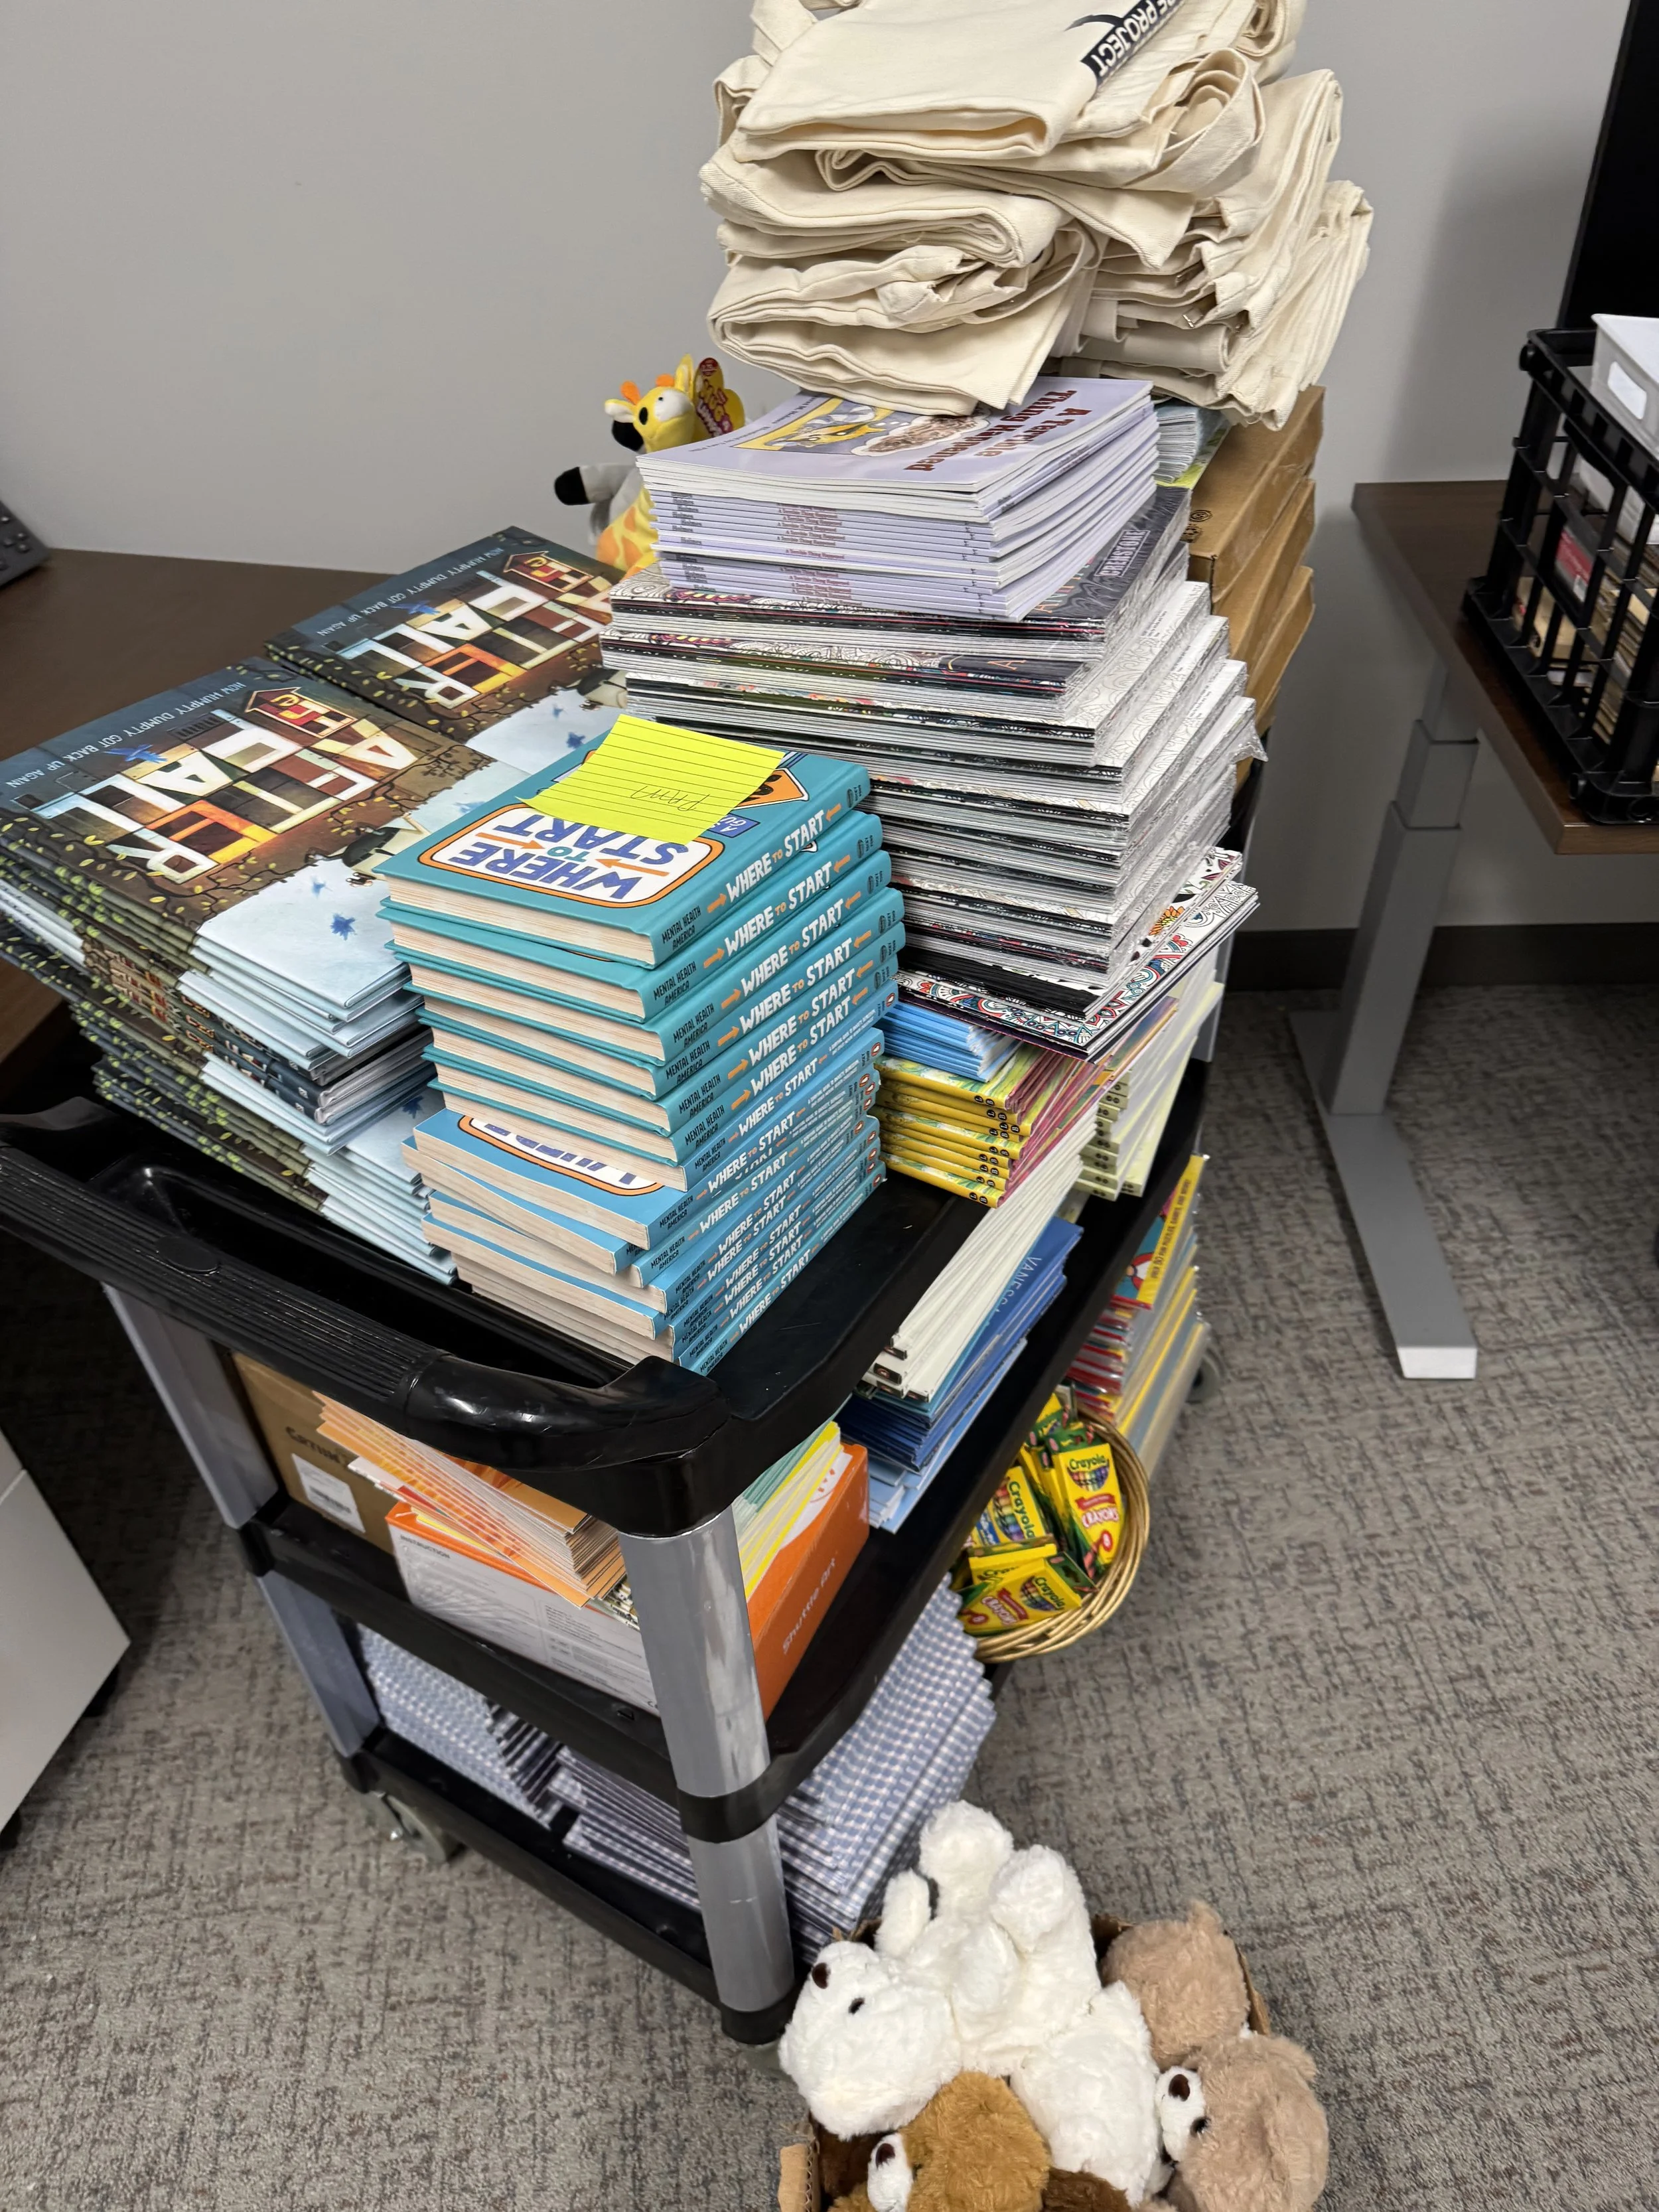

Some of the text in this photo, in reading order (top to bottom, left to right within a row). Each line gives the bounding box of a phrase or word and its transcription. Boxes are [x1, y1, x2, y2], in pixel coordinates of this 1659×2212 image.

[1091, 1, 1158, 76] PROJECT
[904, 390, 1077, 471] Thing Happened
[1055, 407, 1092, 416] A
[316, 548, 504, 636] HOW HUMPTY DUMPTY GOT BACK UP AGAIN
[336, 570, 546, 676] FALL
[394, 575, 612, 709] AFTER
[5, 681, 247, 788] HOW HUMPTY DUMPTY GOT BACK UP AGAIN
[31, 709, 303, 831] FALL
[105, 719, 420, 884] AFTER
[491, 814, 689, 865] START
[449, 842, 642, 899] WHERE
[547, 846, 590, 862] TO
[725, 809, 825, 903] WHERE TO START
[662, 905, 701, 944] MENTAL HEALTH
[724, 861, 832, 958] WHERE TO START
[741, 899, 843, 997] WHERE TO START
[653, 961, 697, 1001] MENTAL HEALTH
[739, 984, 791, 1034] WHERE
[792, 978, 804, 993] TO
[806, 937, 852, 986] START
[748, 1015, 797, 1067] WHERE
[798, 1009, 810, 1024] TO
[812, 968, 855, 1017] START
[665, 1040, 711, 1080] MENTAL HEALTH
[673, 1003, 715, 1043] MENTAL HEALTH
[751, 1044, 797, 1097] WHERE
[797, 1039, 808, 1053] TO
[810, 995, 851, 1045] START
[678, 1074, 721, 1114] MENTAL HEALTH
[685, 1105, 725, 1146] MENTAL HEALTH
[738, 1096, 775, 1137] WHERE
[774, 1092, 784, 1102] TO
[785, 1057, 818, 1097] START
[695, 1136, 727, 1169] MENTAL HEALTH
[699, 1192, 739, 1233] WHERE
[739, 1187, 749, 1199] TO
[751, 1151, 788, 1192] START
[707, 1151, 748, 1193] WHERE
[748, 1147, 757, 1159] TO
[758, 1111, 795, 1152] START
[650, 1247, 669, 1269] MENTAL
[668, 1236, 685, 1255] HEALTH
[659, 1195, 693, 1228] MENTAL HEALTH
[707, 1197, 786, 1282] WHERE TO START
[718, 1170, 796, 1255] WHERE TO START
[725, 1204, 802, 1289] WHERE TO START
[725, 1221, 802, 1305] WHERE TO START
[729, 1234, 804, 1319] WHERE TO START
[739, 1249, 810, 1335] WHERE TO START
[1068, 1455, 1109, 1471] Crayola
[1006, 1481, 1035, 1539] Crayola
[782, 1558, 835, 1655] Shuttle Art
[1033, 1576, 1066, 1611] Crayola
